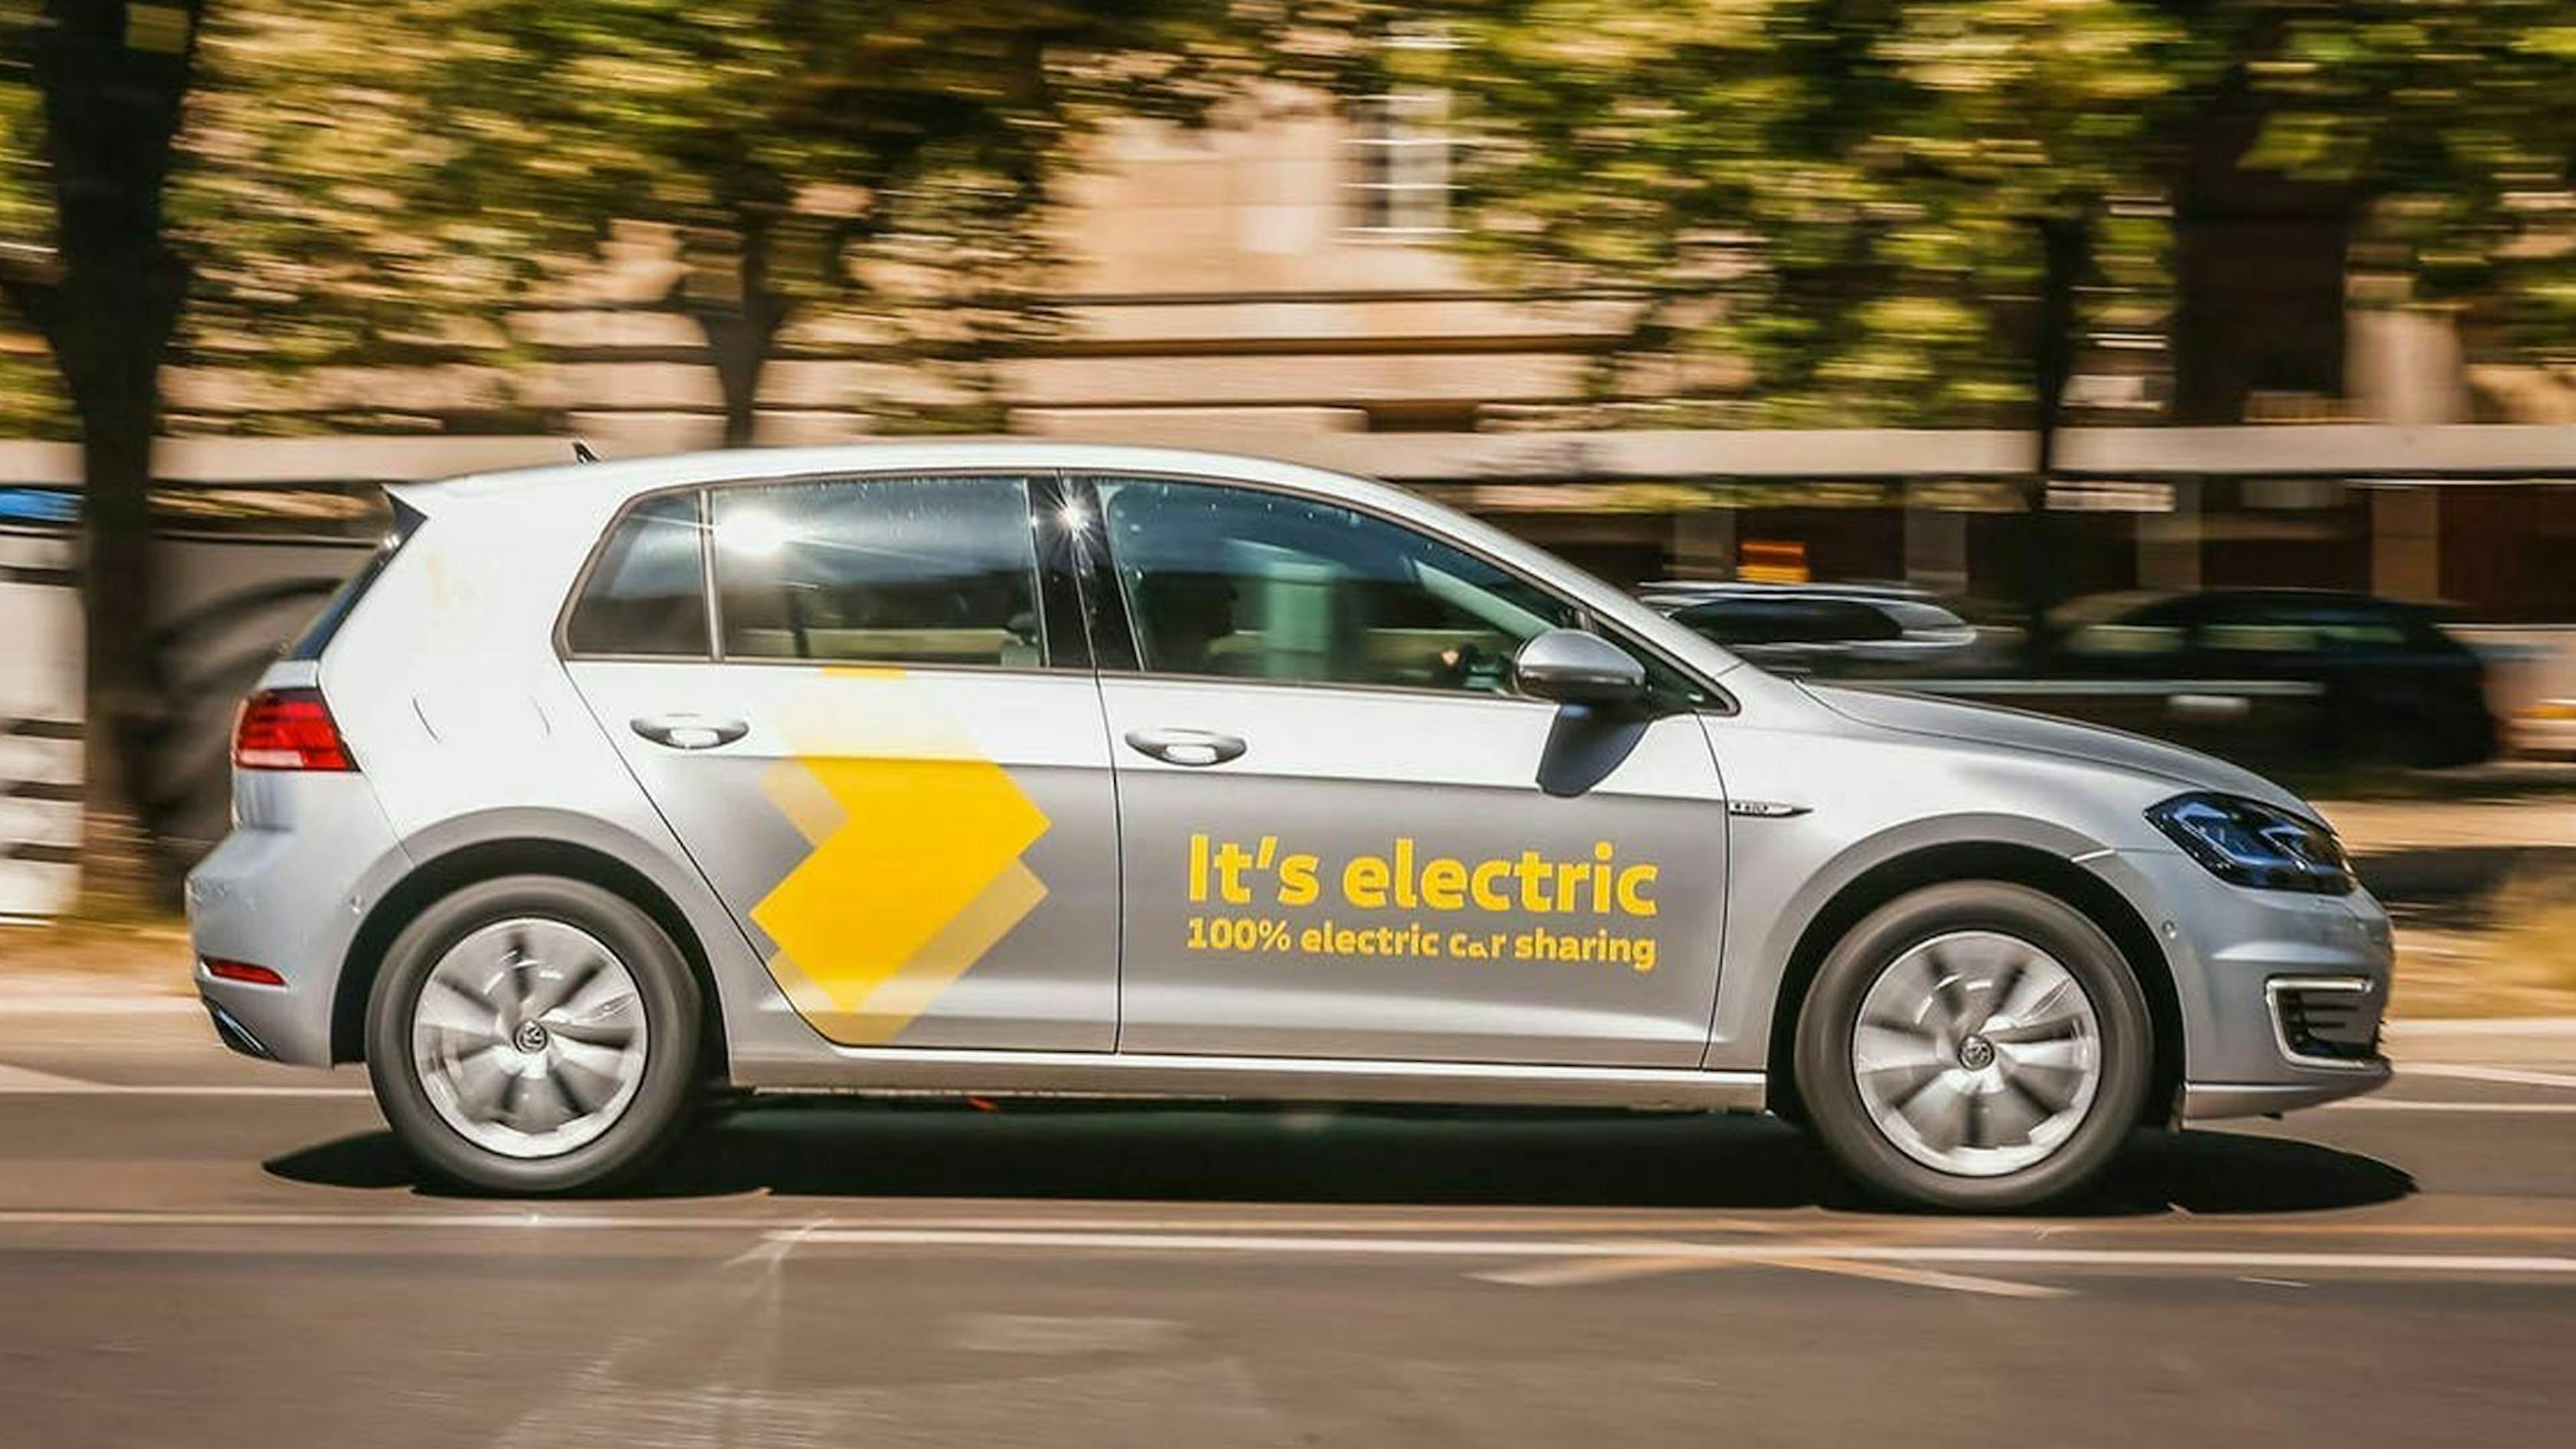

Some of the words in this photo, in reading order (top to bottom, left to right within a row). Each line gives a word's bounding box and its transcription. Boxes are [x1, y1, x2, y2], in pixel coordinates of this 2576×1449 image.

[1189, 835, 1320, 906] It's
[1342, 838, 1658, 916] electric
[1187, 917, 1291, 952] 100%
[1300, 923, 1440, 957] electric
[1448, 932, 1507, 959] car
[1514, 928, 1656, 972] sharing
